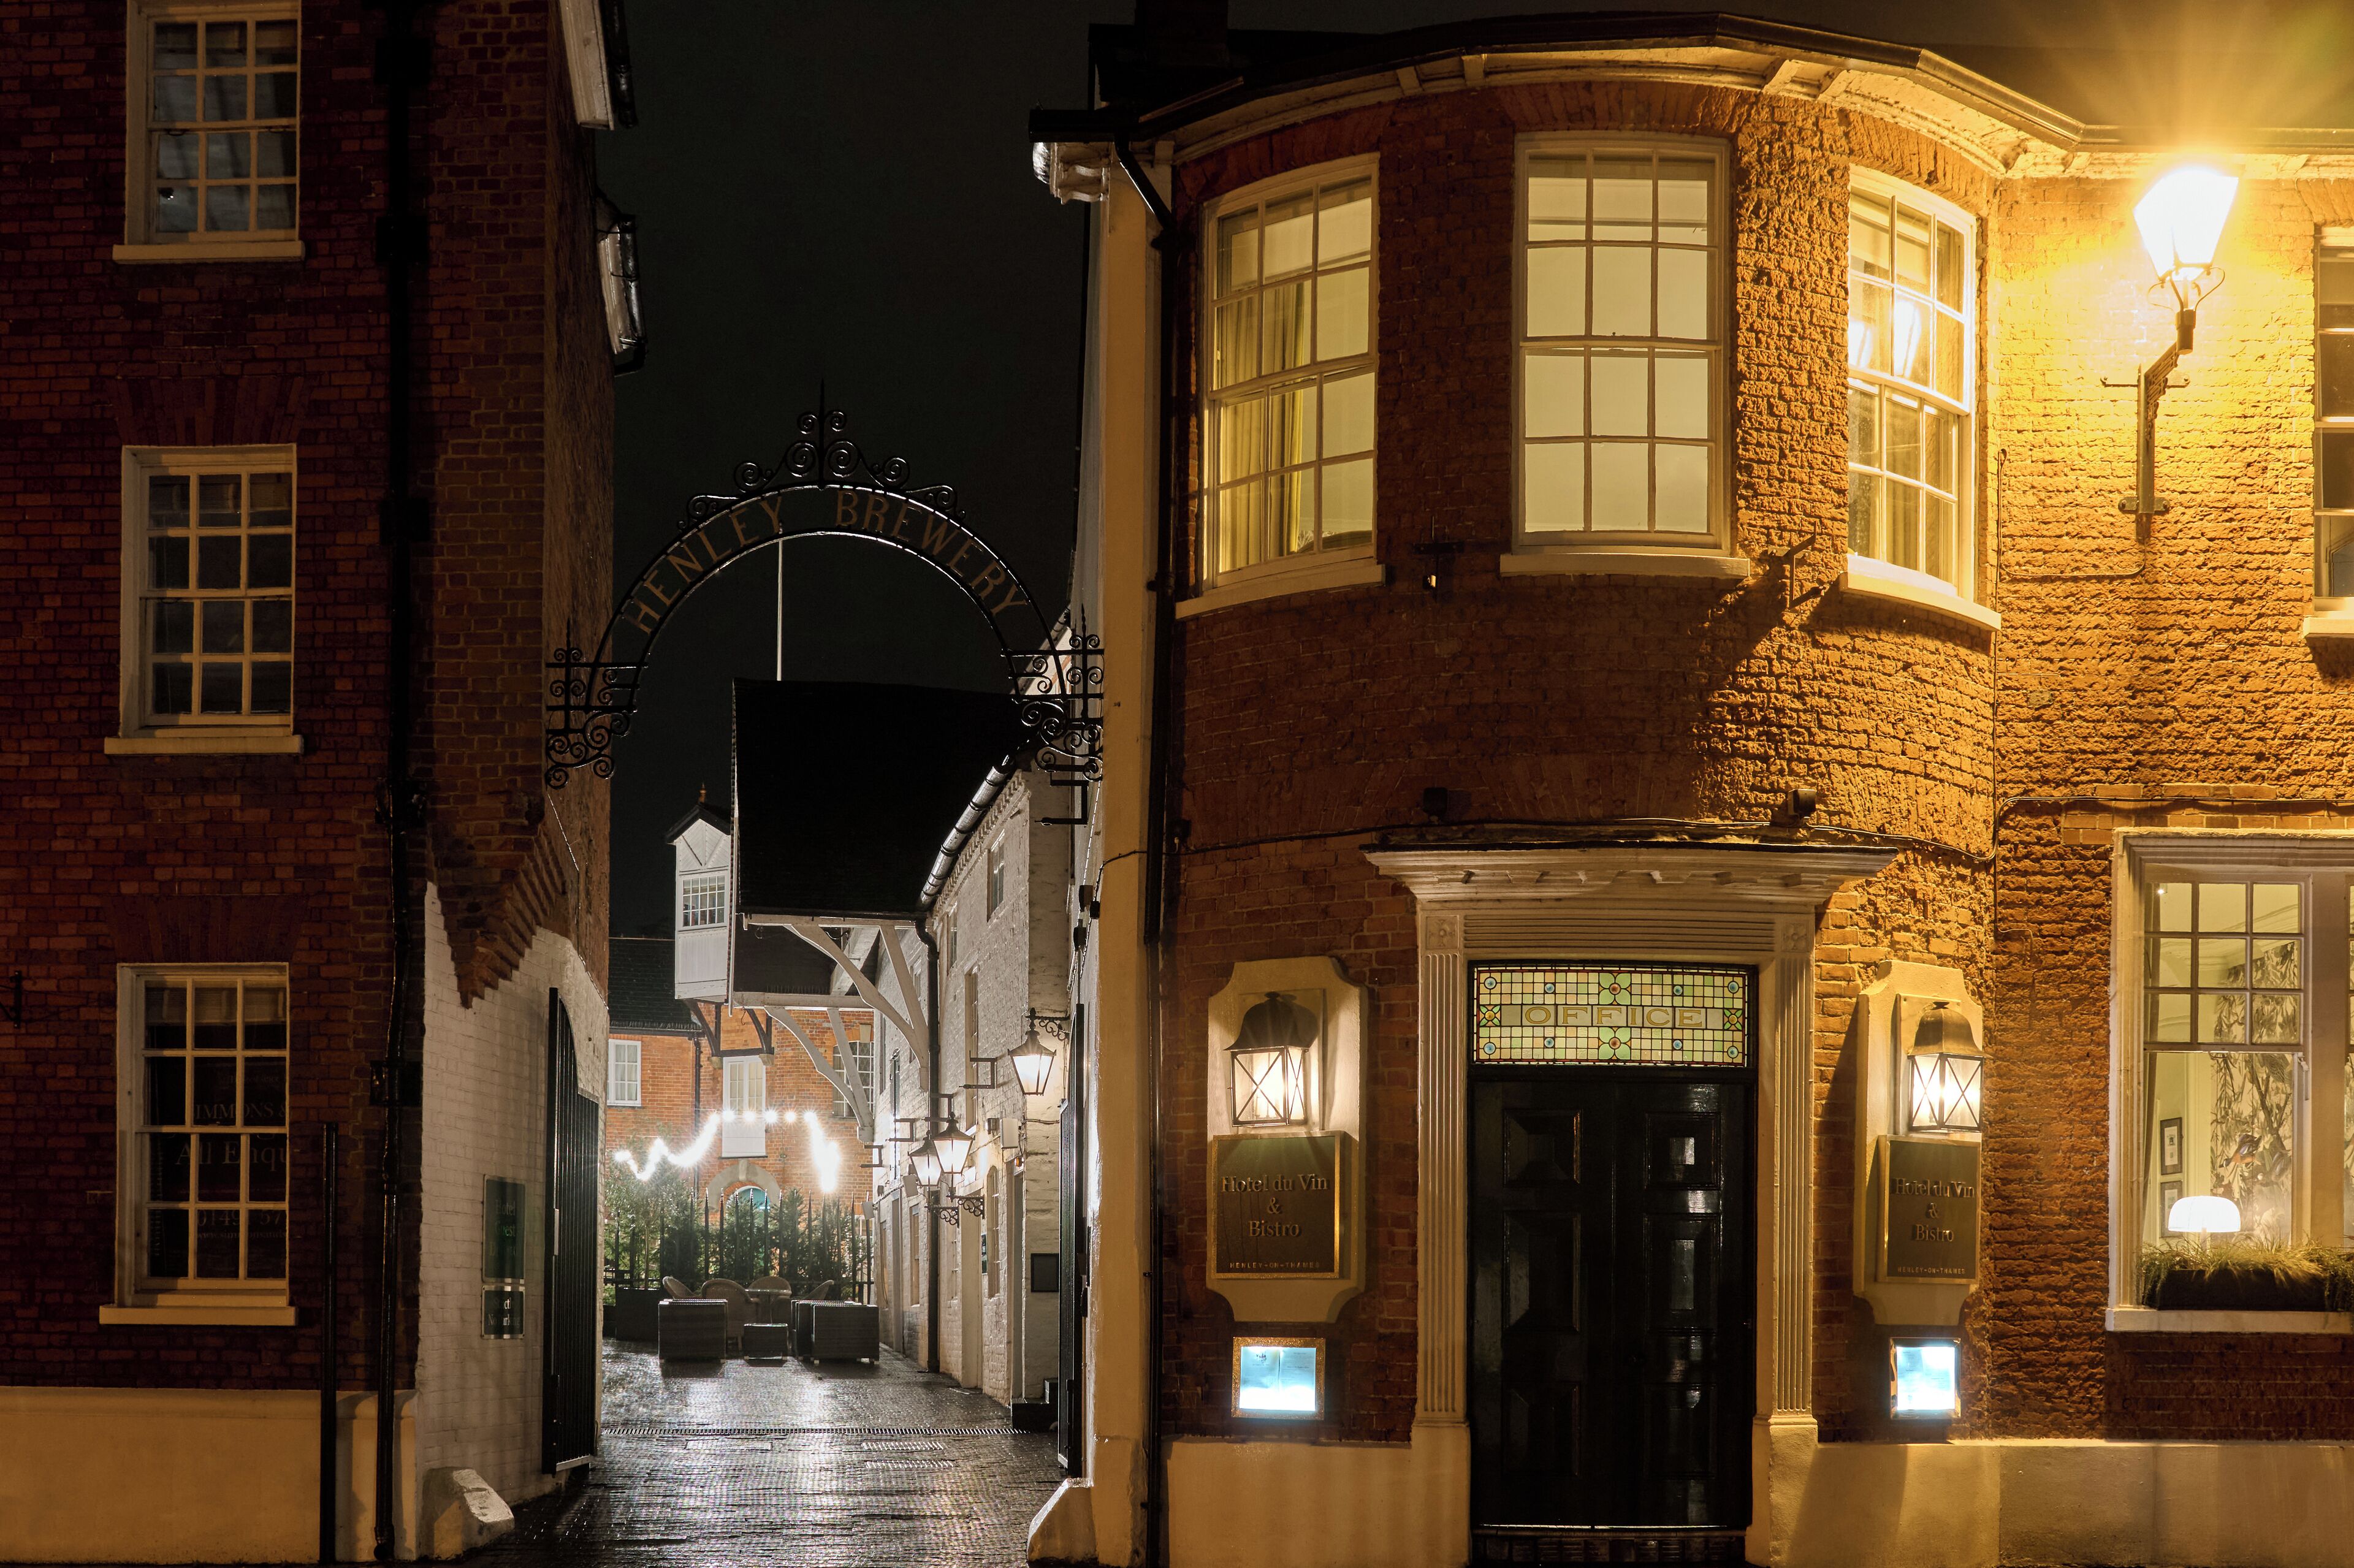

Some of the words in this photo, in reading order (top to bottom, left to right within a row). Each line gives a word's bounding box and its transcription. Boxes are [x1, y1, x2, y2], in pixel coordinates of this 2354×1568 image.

[620, 494, 784, 634] HENLEY
[834, 489, 1027, 618] BREWERY
[1525, 1006, 1702, 1027] OFFICE
[1221, 1174, 1268, 1192] Hotel
[1273, 1173, 1293, 1191] du
[1297, 1173, 1328, 1190] Vin
[1895, 1177, 1930, 1196] Hotel
[1934, 1180, 1950, 1197] du
[1950, 1181, 1975, 1198] Vin
[1268, 1197, 1281, 1214] &
[1928, 1202, 1939, 1219] &
[1249, 1220, 1300, 1237] Bistro
[1916, 1224, 1954, 1242] Bistro
